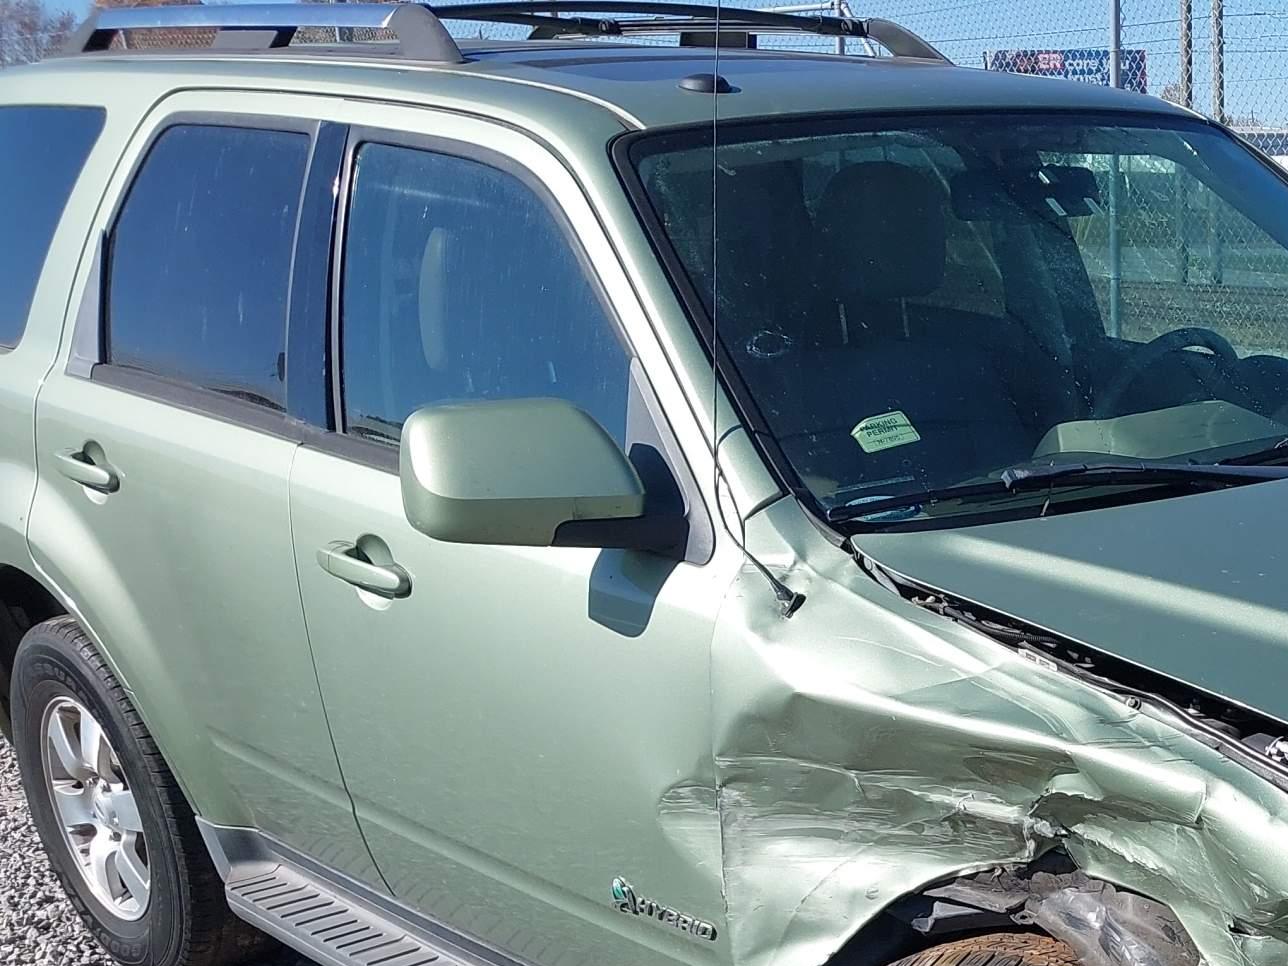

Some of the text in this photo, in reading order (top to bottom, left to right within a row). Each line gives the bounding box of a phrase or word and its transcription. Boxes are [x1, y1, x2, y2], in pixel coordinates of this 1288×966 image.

[1065, 59, 1099, 69] care
[1102, 58, 1129, 73] yu
[860, 417, 898, 432] PARKING
[866, 425, 898, 438] PERMIT
[637, 896, 718, 941] HYBRID
